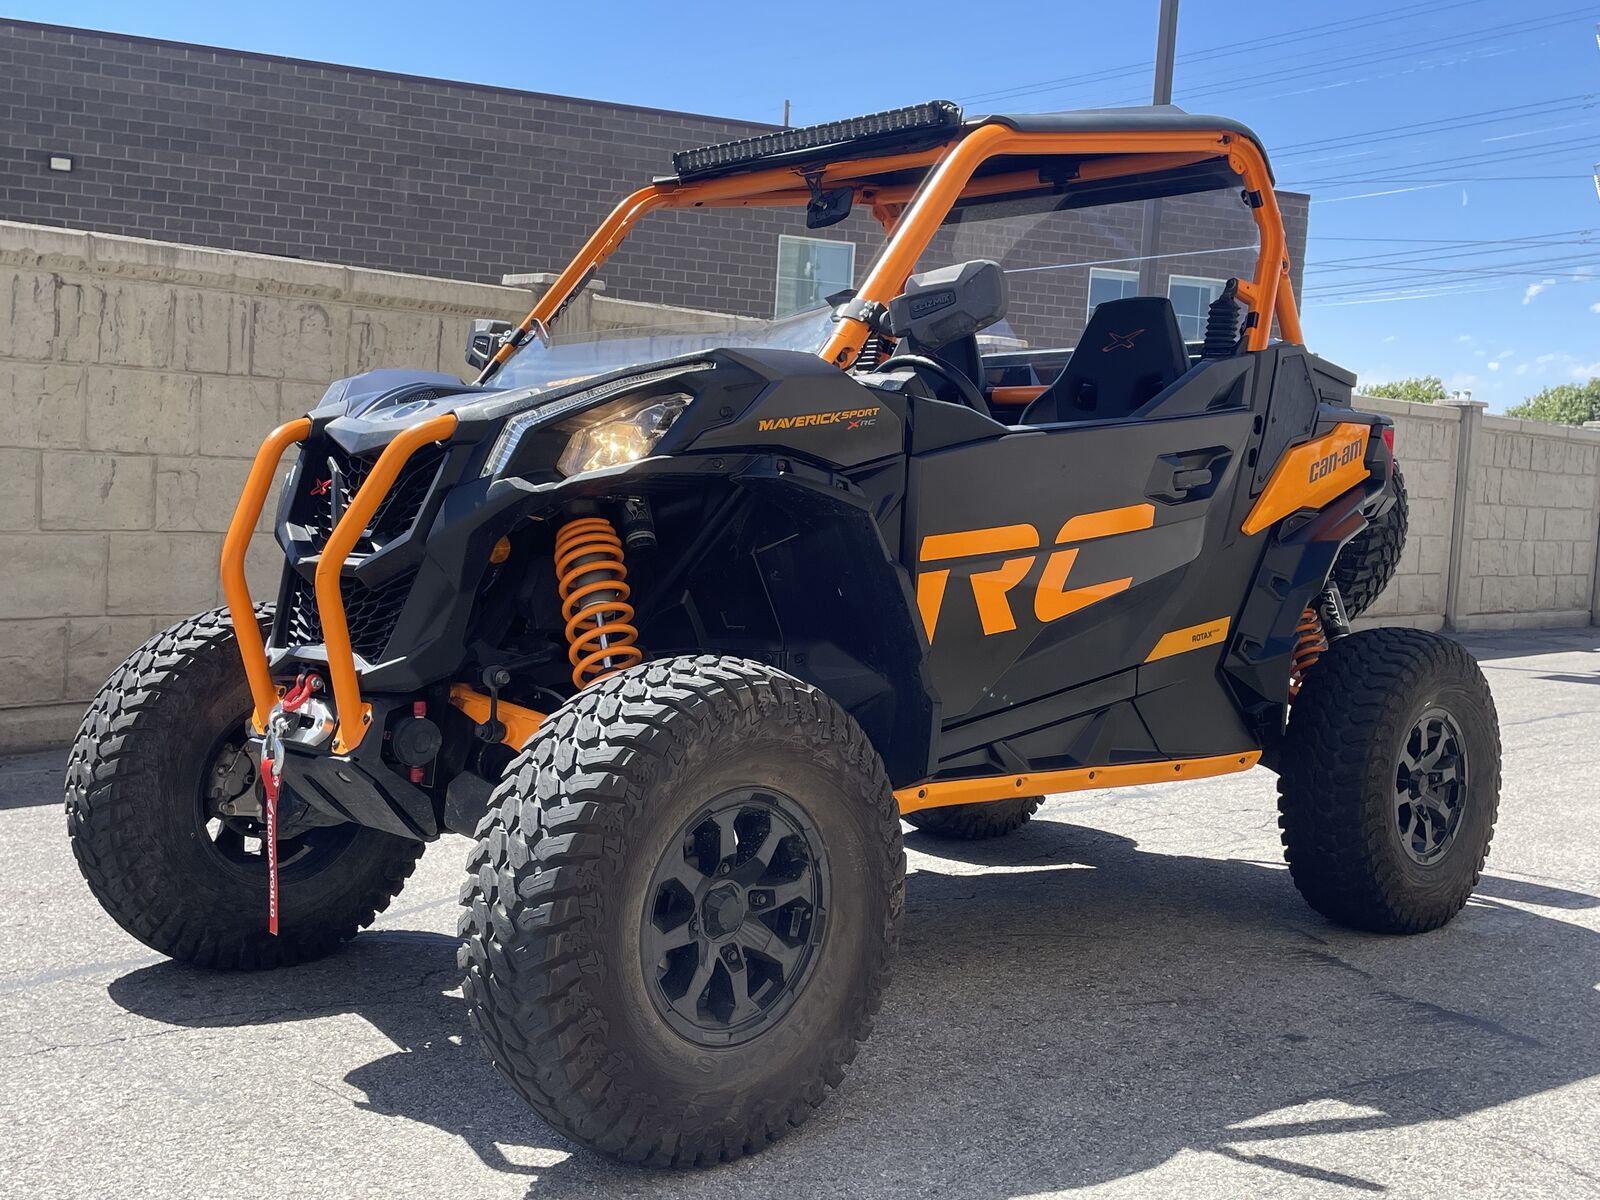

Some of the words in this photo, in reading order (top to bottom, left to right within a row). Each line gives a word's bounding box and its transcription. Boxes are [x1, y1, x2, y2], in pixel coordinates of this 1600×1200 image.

[1308, 438, 1363, 484] can-am
[916, 502, 1156, 646] RC
[1191, 630, 1213, 643] ROTAX
